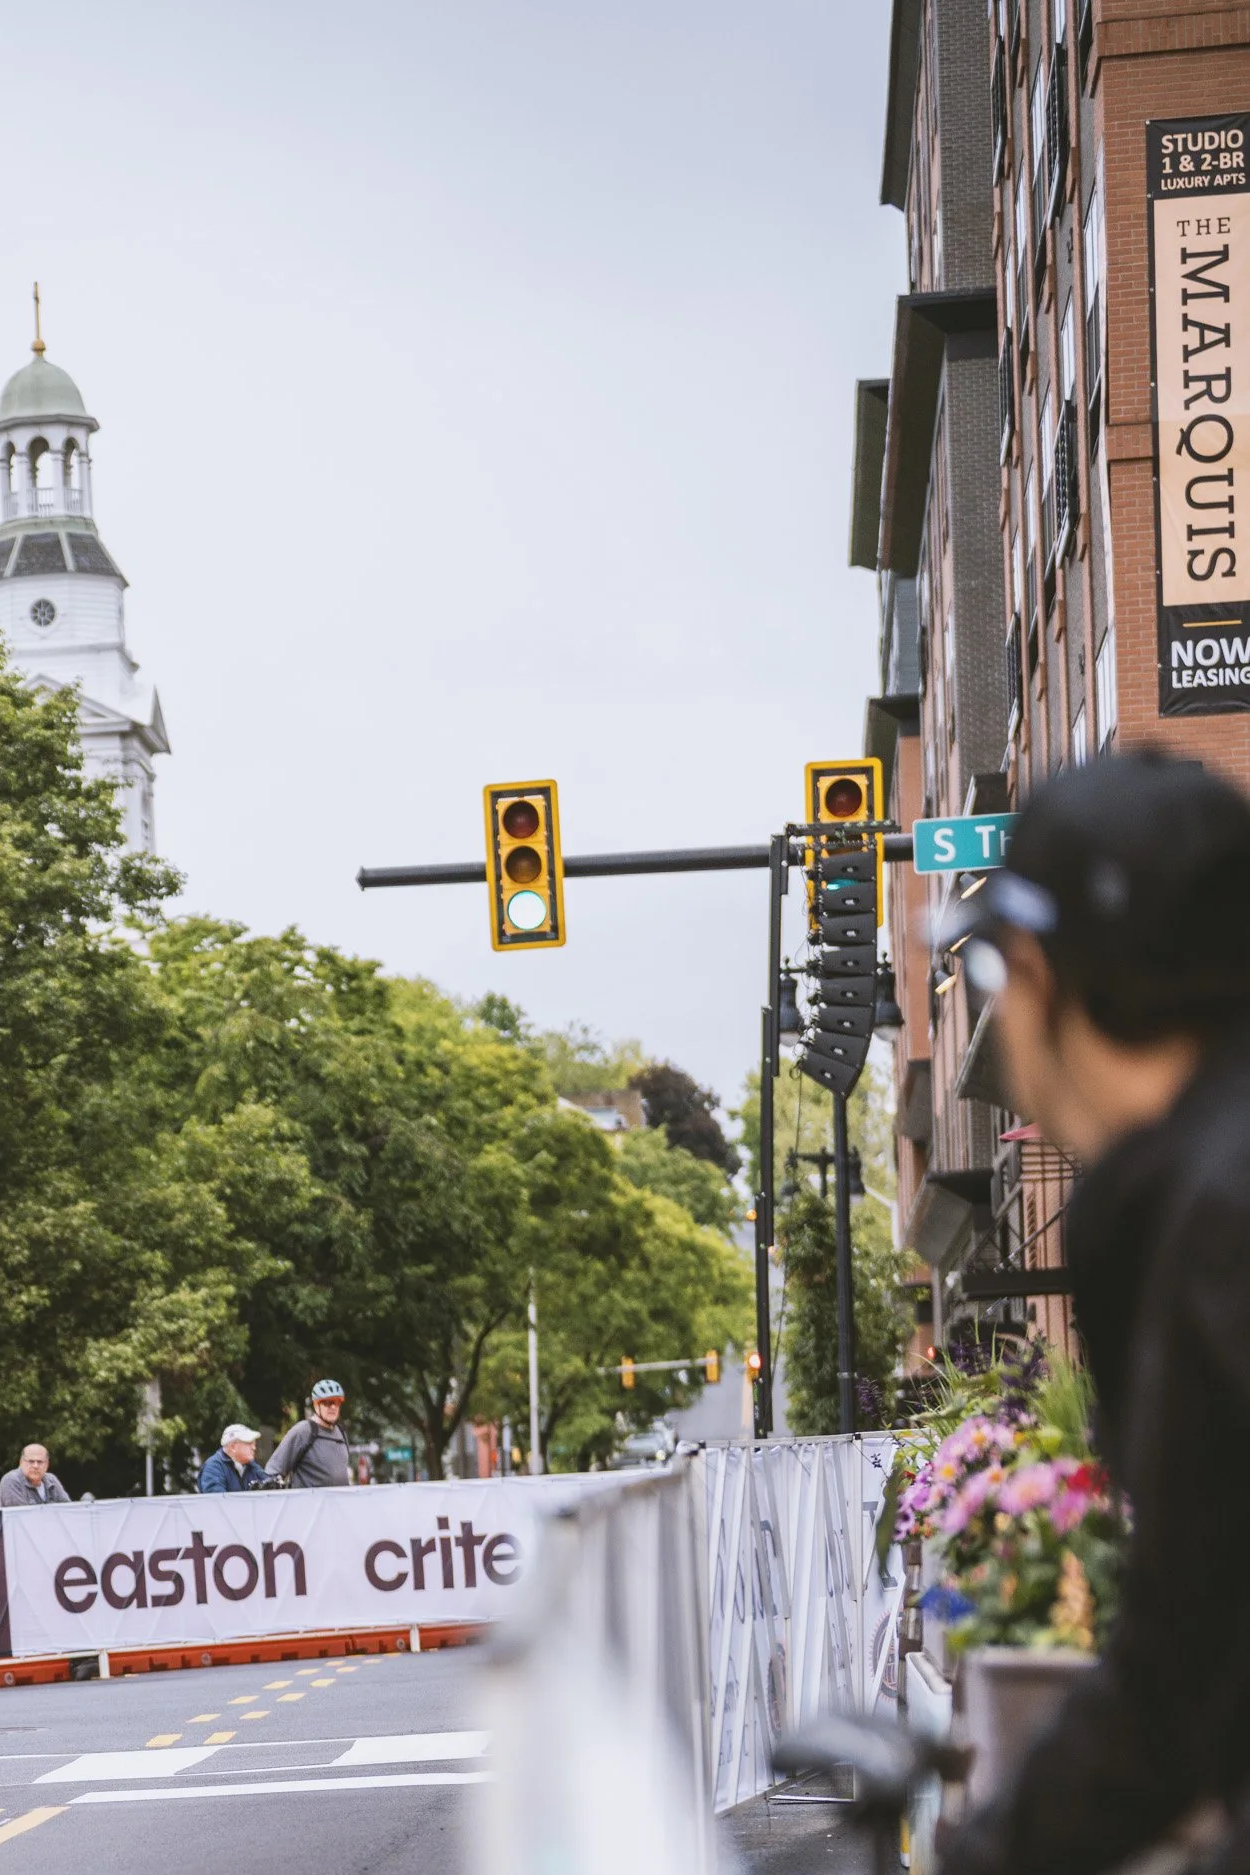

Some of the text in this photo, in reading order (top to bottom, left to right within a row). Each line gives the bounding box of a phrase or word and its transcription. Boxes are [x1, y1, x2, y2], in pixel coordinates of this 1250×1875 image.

[1161, 129, 1244, 154] STUDIO
[1162, 151, 1245, 174] 1 & 2-BR
[1161, 173, 1247, 191] LUXURY APTS
[1176, 216, 1231, 237] THE
[1175, 243, 1237, 582] MARQUIS
[1171, 636, 1250, 668] NOW
[1171, 666, 1250, 689] LEASING
[933, 827, 956, 863] S
[54, 1531, 307, 1614] easton
